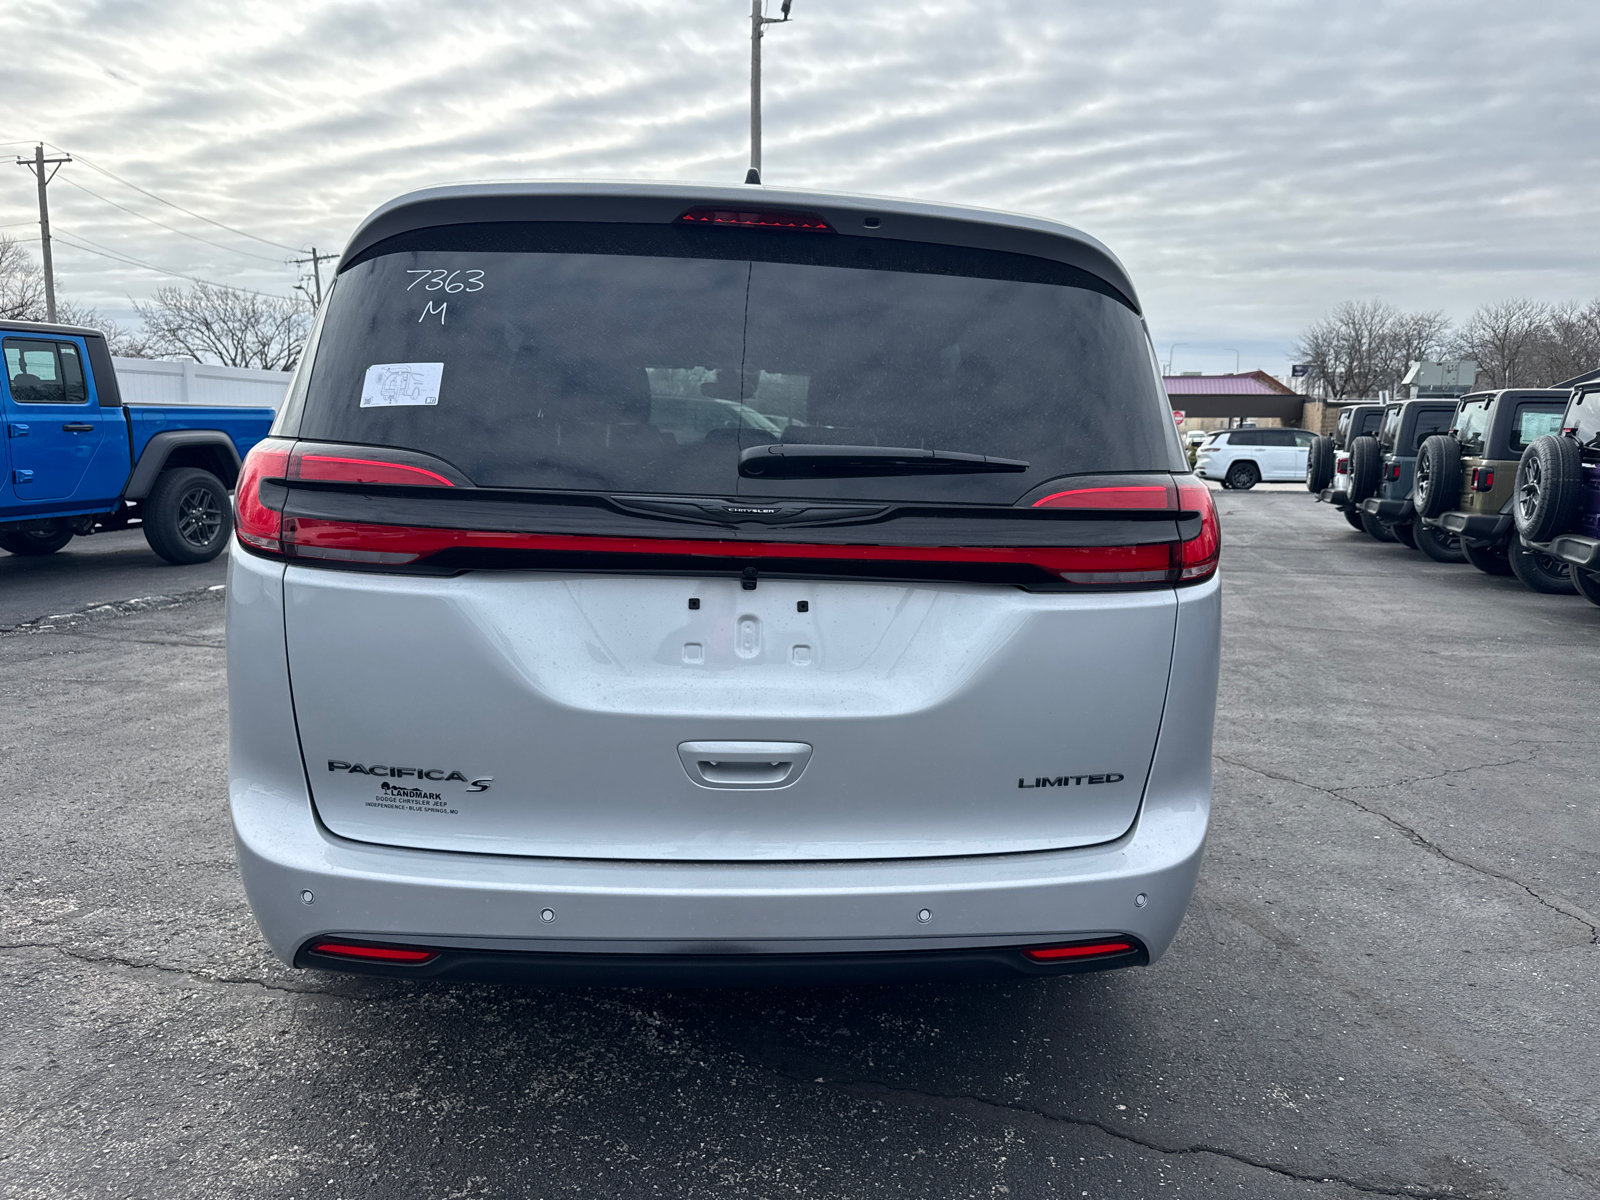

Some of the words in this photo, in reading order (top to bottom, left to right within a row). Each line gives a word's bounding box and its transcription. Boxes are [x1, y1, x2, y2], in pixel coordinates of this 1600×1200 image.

[406, 269, 485, 293] 7363
[418, 301, 447, 325] M
[327, 759, 468, 782] PACIFICA
[466, 776, 494, 792] S
[1018, 773, 1125, 788] LIMITED
[391, 789, 442, 800] LANDMARK
[398, 797, 431, 806] CHRYSLER
